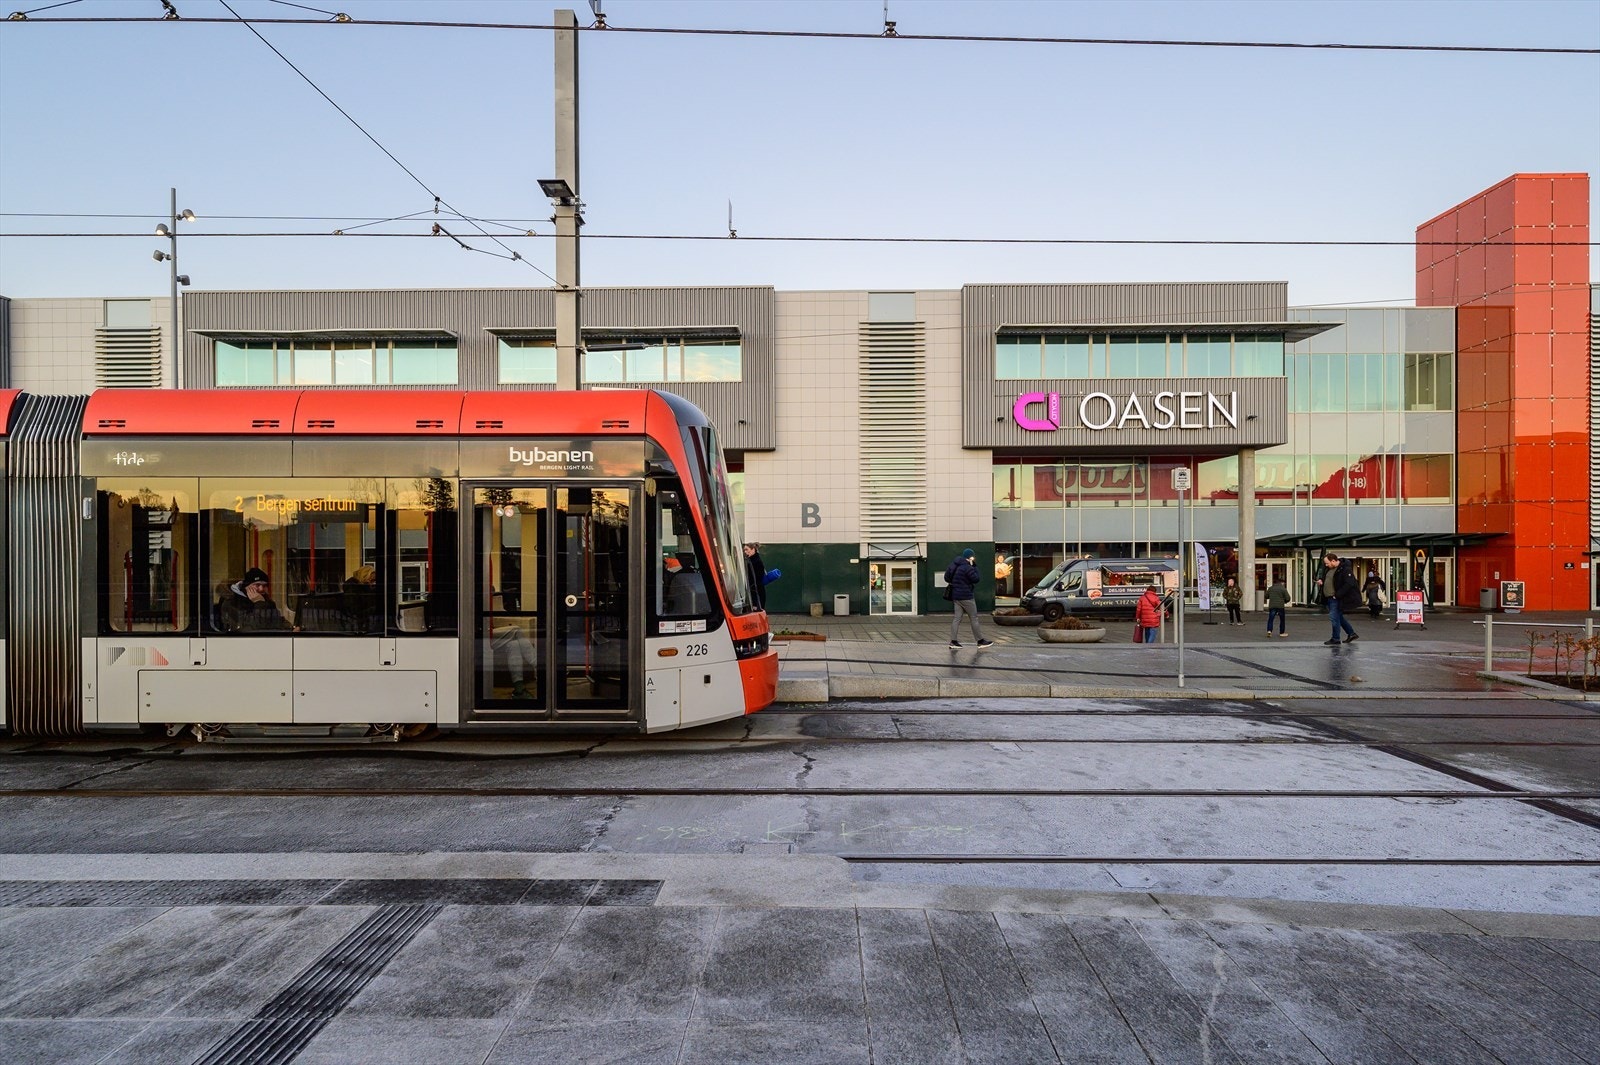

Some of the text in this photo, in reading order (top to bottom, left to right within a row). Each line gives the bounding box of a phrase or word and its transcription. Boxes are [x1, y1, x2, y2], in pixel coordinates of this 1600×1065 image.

[1079, 391, 1237, 430] OASEN
[509, 446, 594, 466] bybanen
[235, 494, 357, 515] 2 Bergen sentrum
[802, 503, 821, 528] B
[686, 643, 708, 656] 226
[647, 677, 654, 686] A
